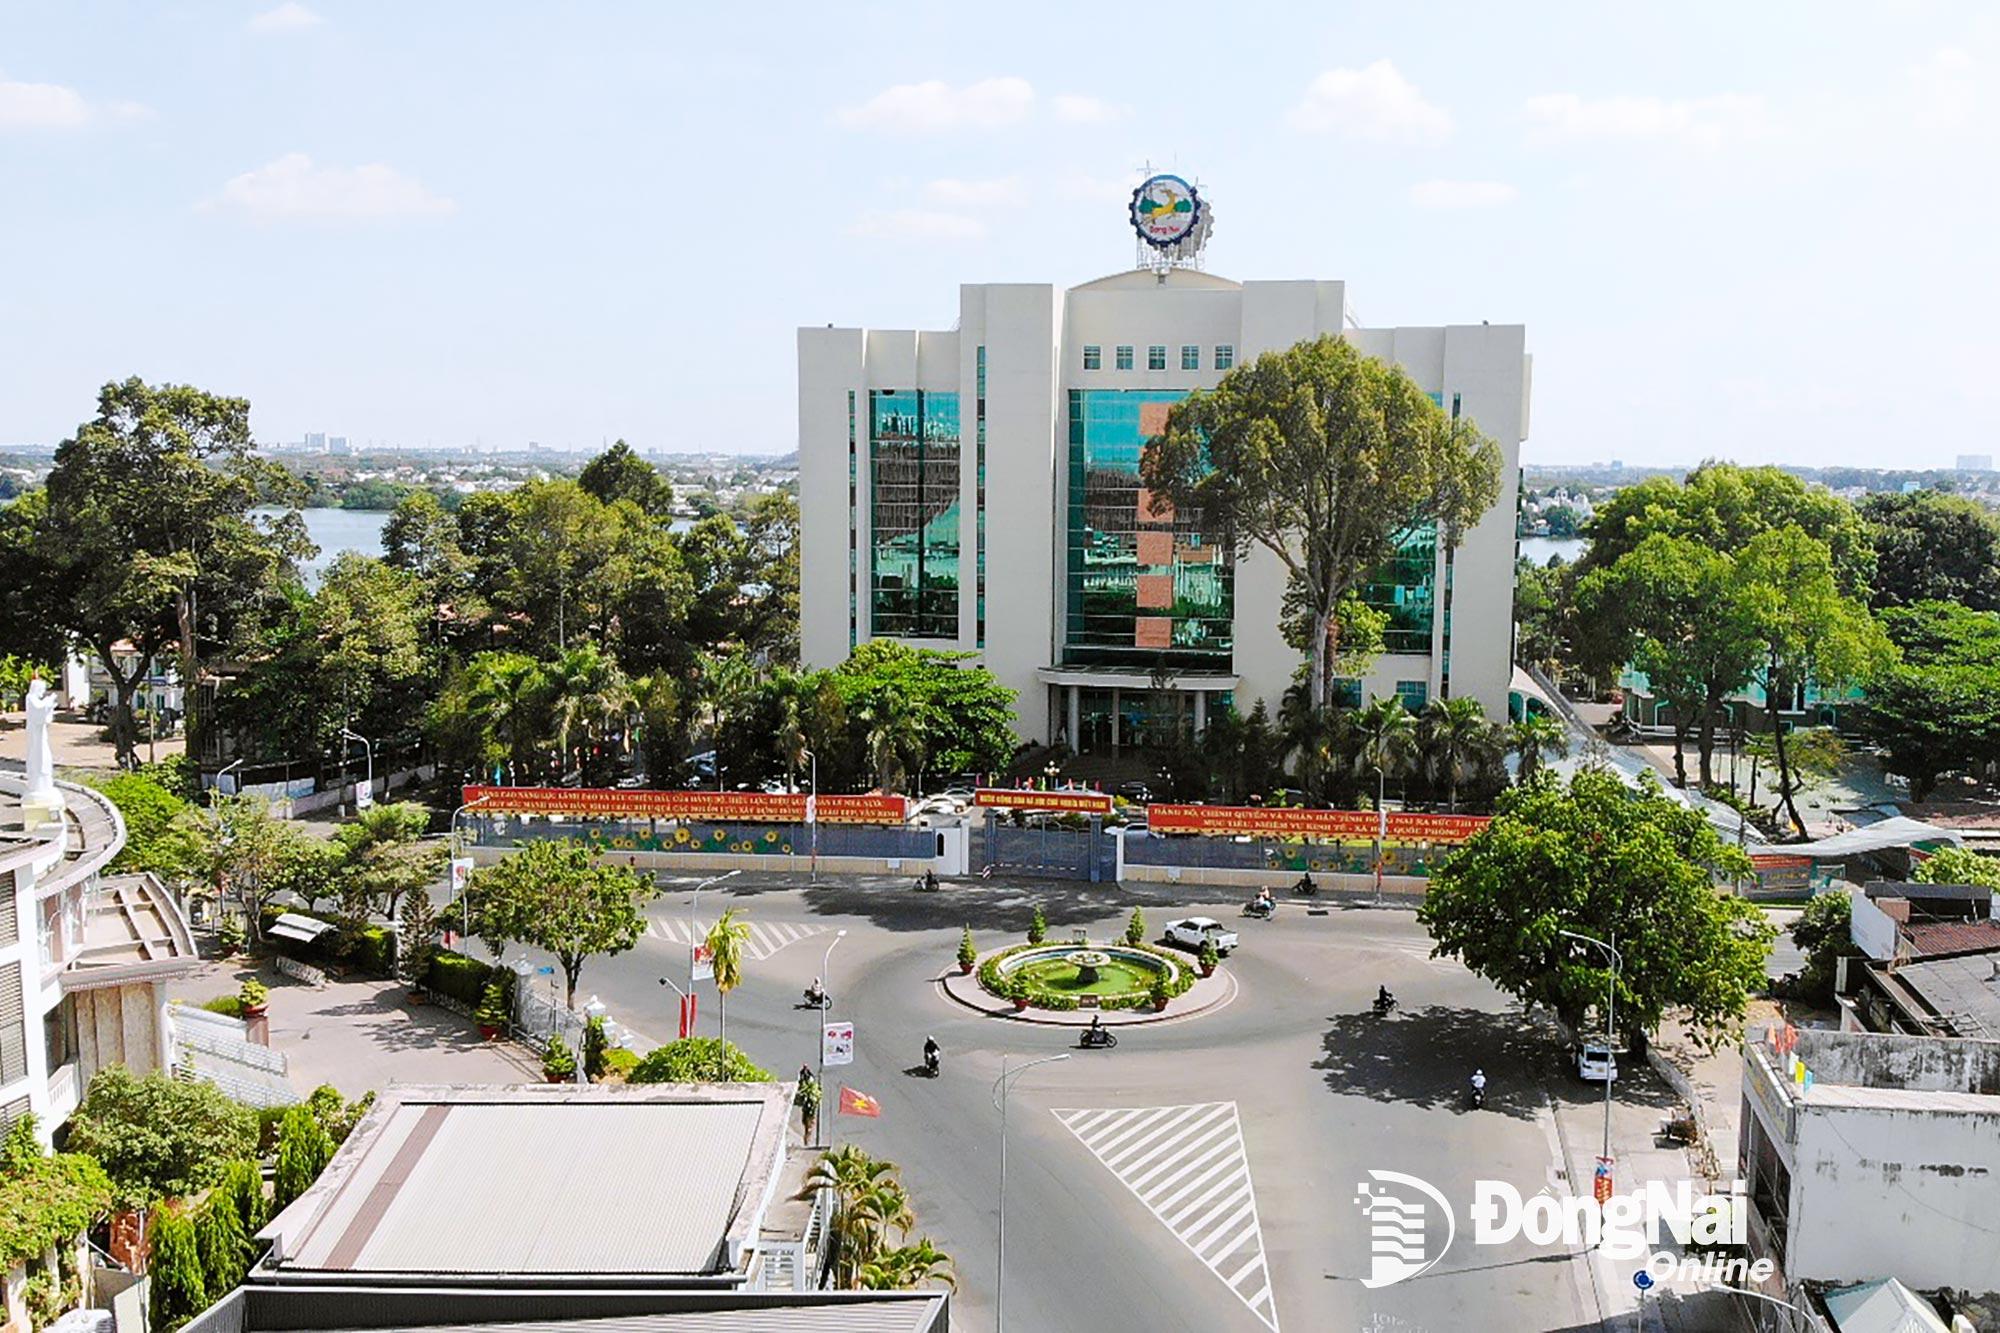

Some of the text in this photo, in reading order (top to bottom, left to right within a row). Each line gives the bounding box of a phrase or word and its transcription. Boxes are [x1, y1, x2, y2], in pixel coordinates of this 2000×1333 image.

[1154, 807, 1181, 817] ĐẢNG
[1200, 809, 1233, 818] CHÍNH
[1234, 808, 1268, 820] QUYỀN
[1269, 810, 1283, 820] VÀ
[1286, 811, 1314, 821] NHÂN
[1315, 812, 1337, 822] DÂN
[1338, 813, 1363, 823] TỈNH
[1366, 813, 1393, 824] ĐỒG
[1396, 816, 1413, 825] NAI
[1415, 817, 1430, 826] RA
[1431, 815, 1452, 827] SỨC
[1456, 818, 1472, 828] THI
[1204, 818, 1225, 828] MỤC
[1255, 820, 1288, 830] NHIỆM
[1290, 821, 1303, 830] VỤ
[1306, 822, 1332, 832] KINH
[1333, 822, 1347, 833] TẾ
[1354, 823, 1368, 833] XÃ
[1393, 824, 1422, 835] QUỐC
[1424, 826, 1460, 837] PHÒNG
